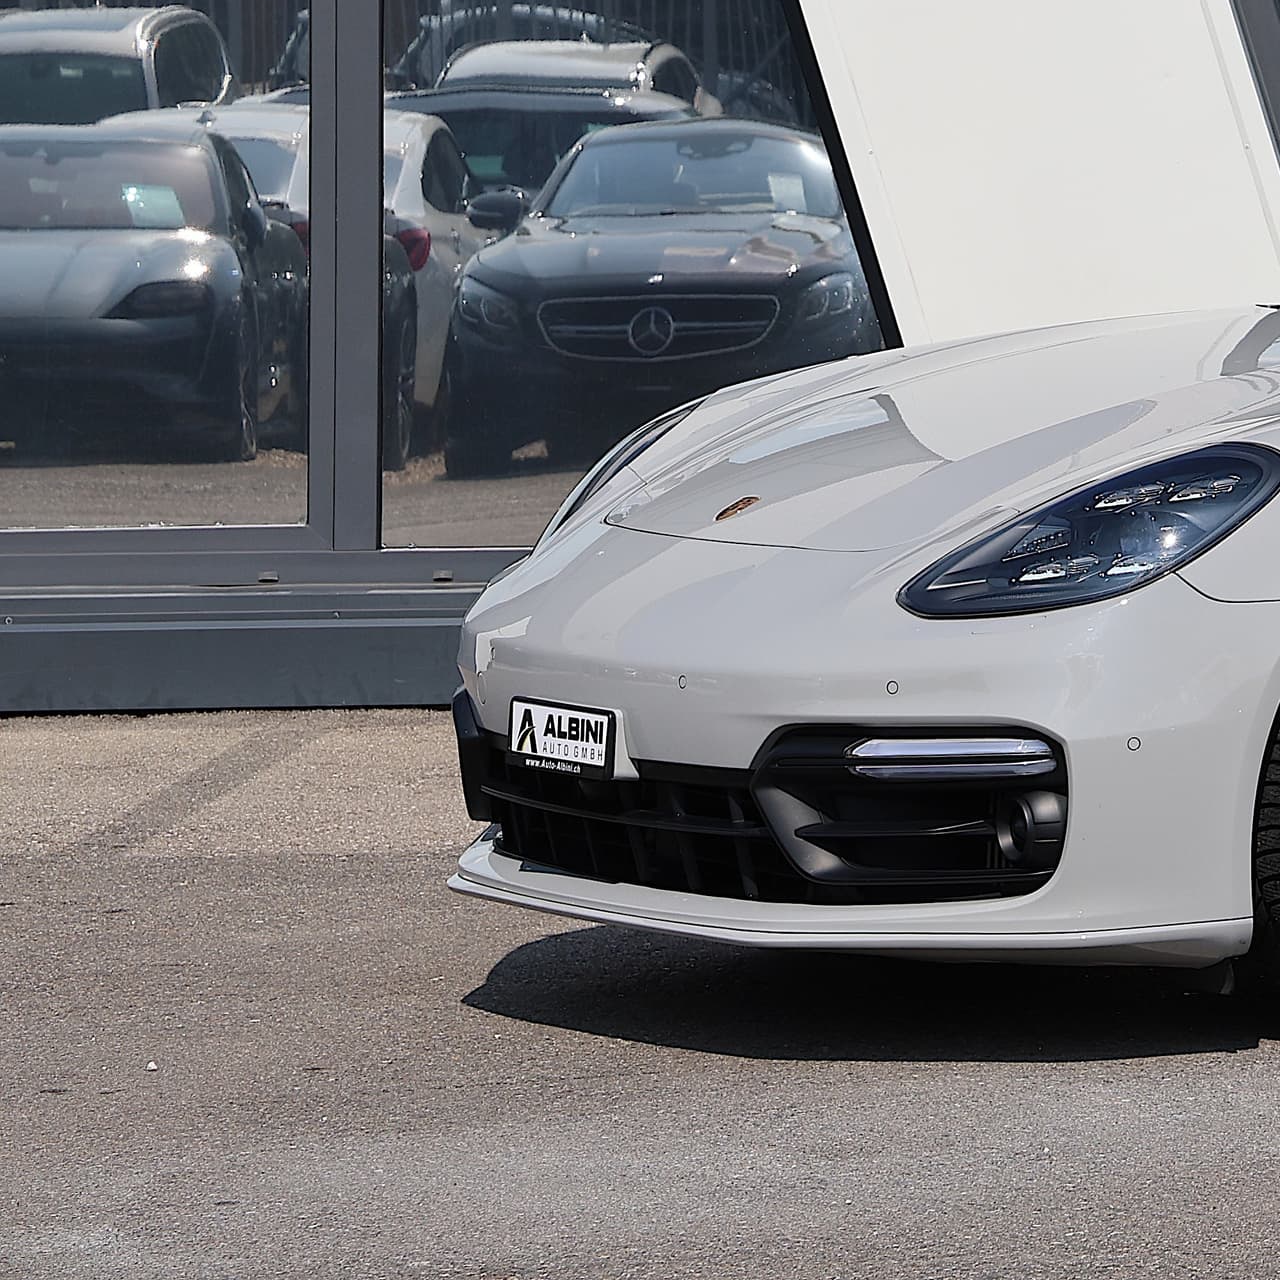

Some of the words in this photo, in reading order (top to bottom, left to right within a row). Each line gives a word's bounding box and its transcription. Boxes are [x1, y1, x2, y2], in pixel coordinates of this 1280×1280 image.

[543, 713, 604, 745] ALBINI
[542, 741, 570, 757] AUTO
[573, 745, 604, 761] GMBH
